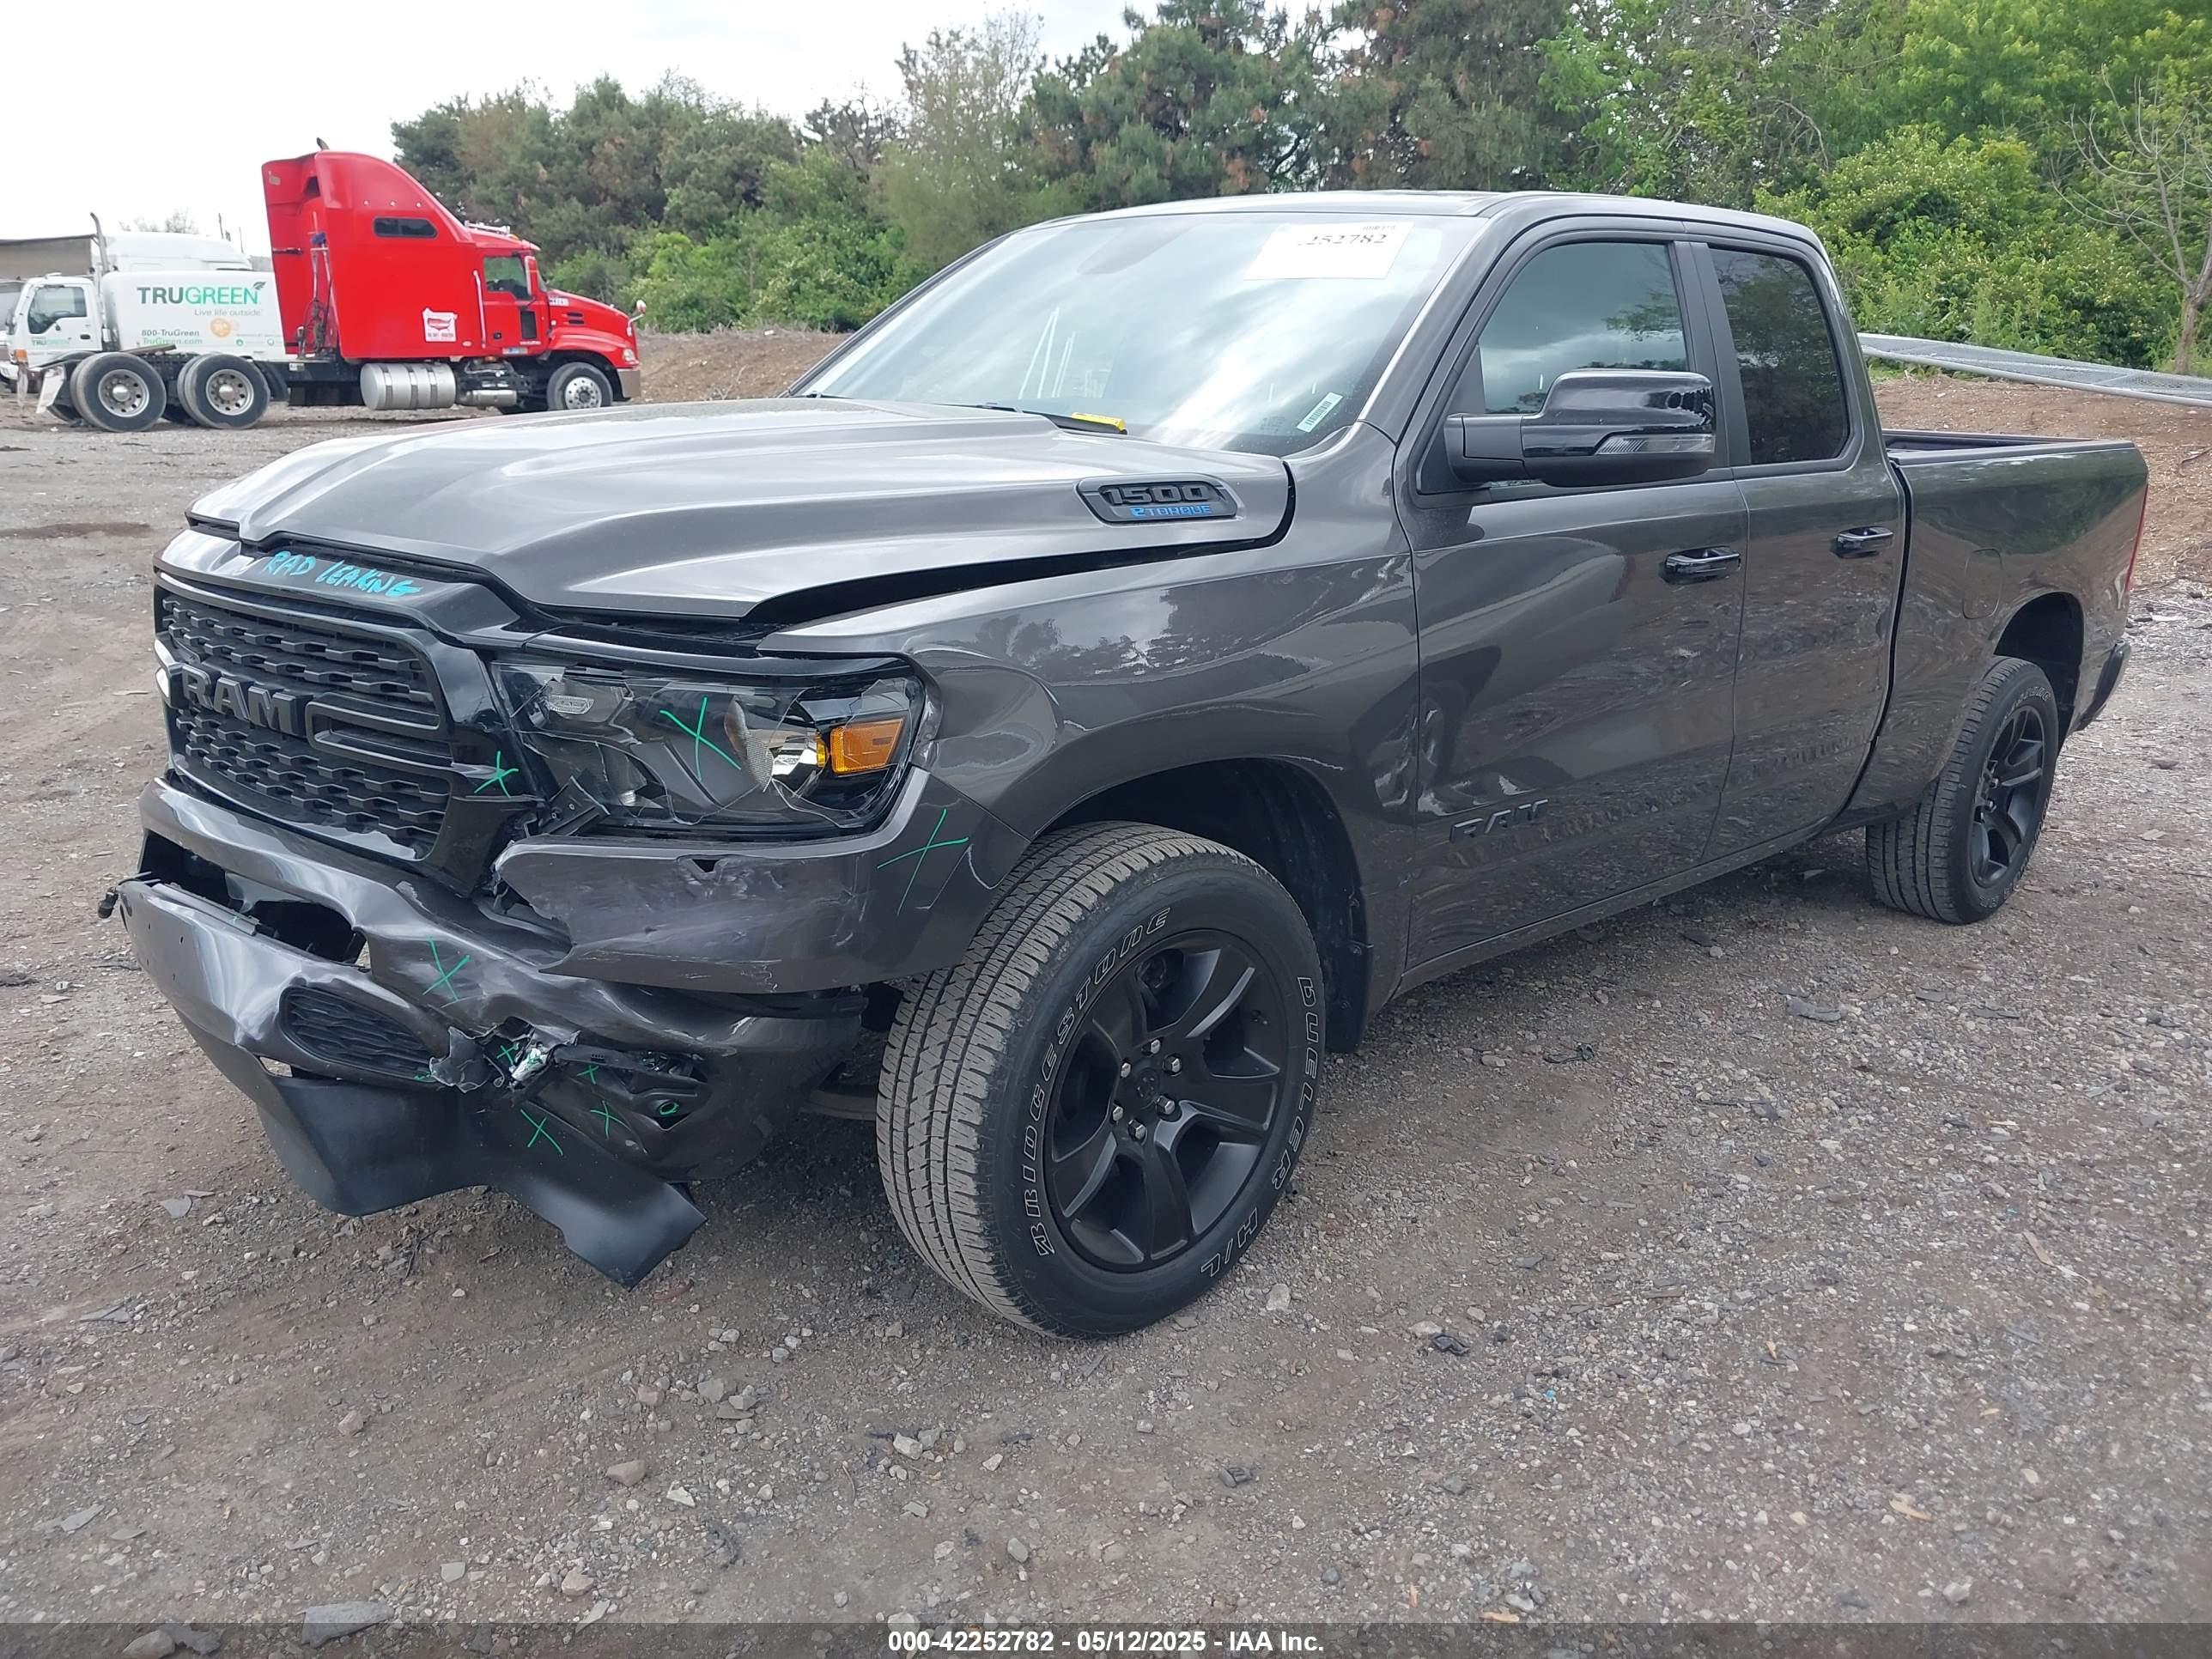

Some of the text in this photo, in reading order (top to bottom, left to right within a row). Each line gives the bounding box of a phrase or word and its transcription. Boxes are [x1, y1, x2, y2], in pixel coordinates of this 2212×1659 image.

[137, 287, 258, 304] TRUGREEN
[1102, 484, 1211, 505] 1500
[264, 550, 317, 575] RAD
[182, 665, 309, 739] RAM
[1023, 907, 1170, 1257] BRIDGESTONE
[1273, 975, 1320, 1192] DUELER
